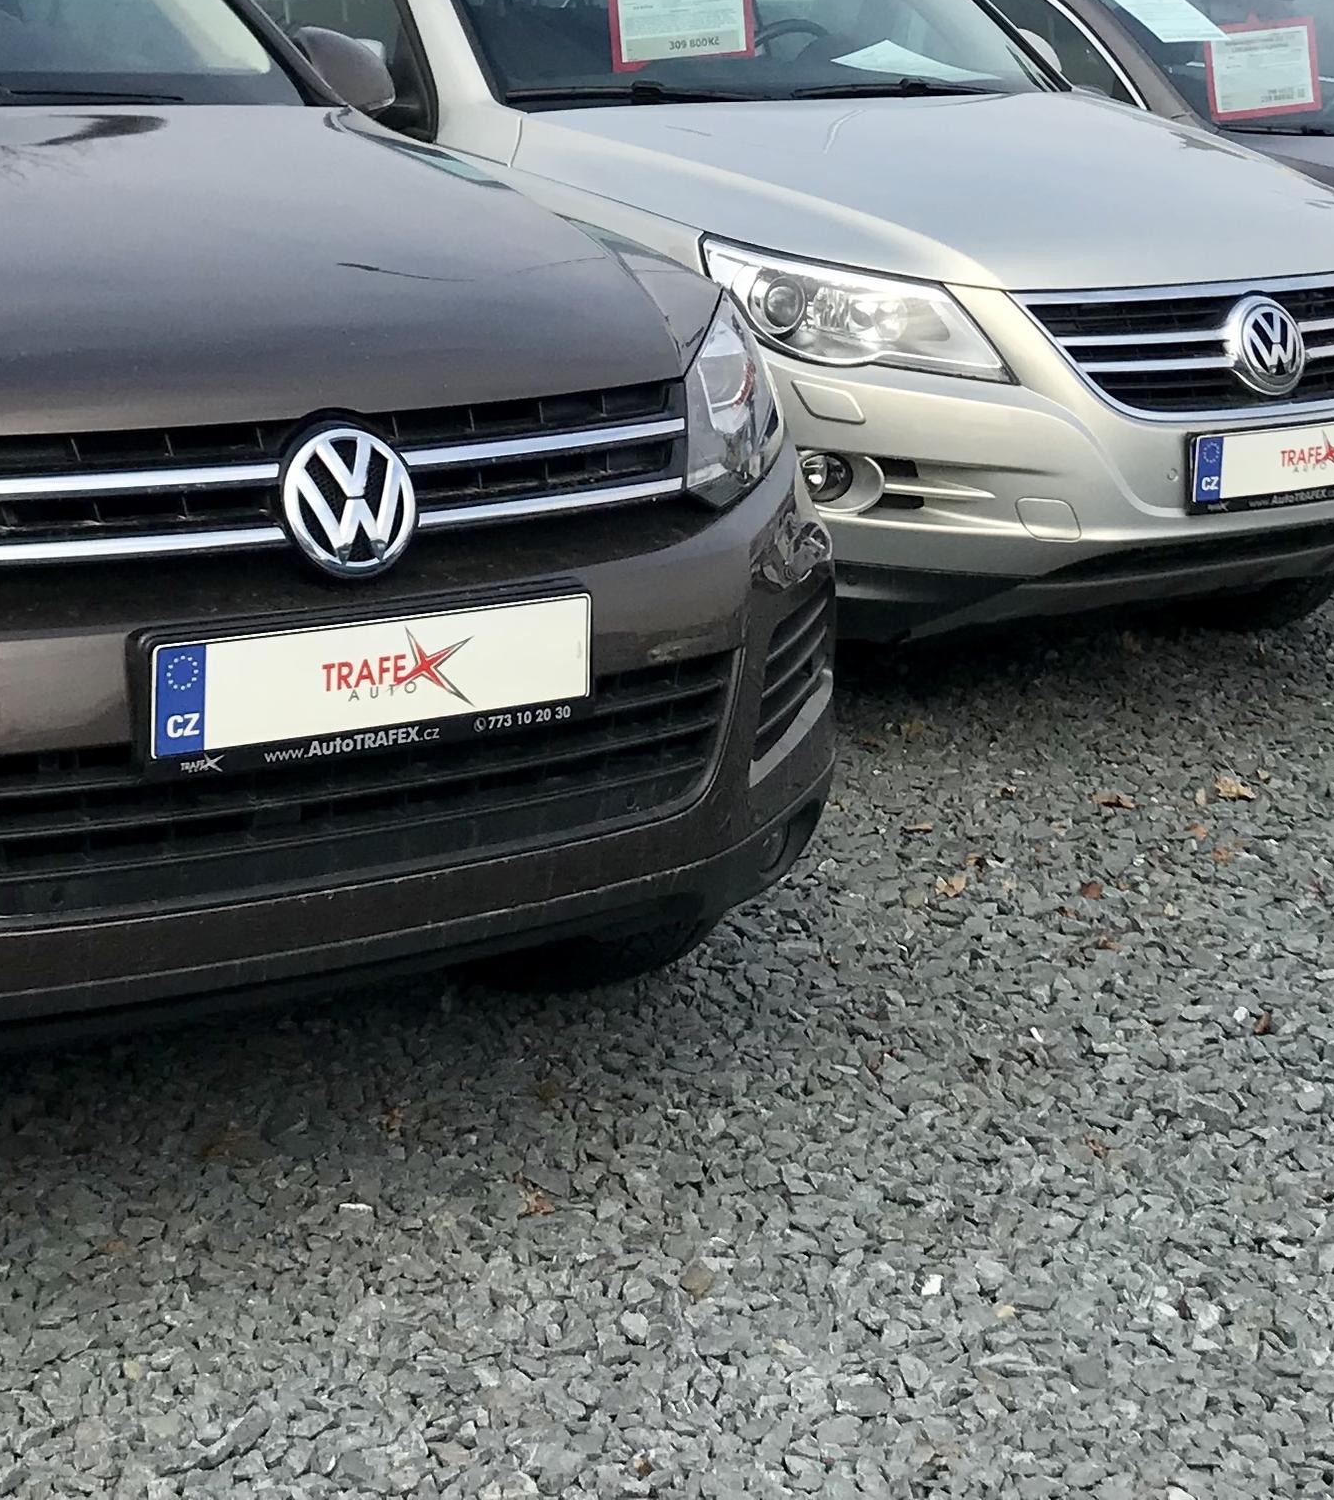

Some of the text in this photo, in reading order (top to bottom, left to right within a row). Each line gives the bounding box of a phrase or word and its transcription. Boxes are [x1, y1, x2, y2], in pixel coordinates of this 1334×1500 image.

[668, 40, 688, 51] 309
[1201, 476, 1219, 491] CZ
[348, 681, 417, 702] AUTO
[167, 712, 200, 738] CZ
[487, 706, 572, 730] 773 10 20 30
[264, 727, 441, 763] www.AutoTRAFEX.cz
